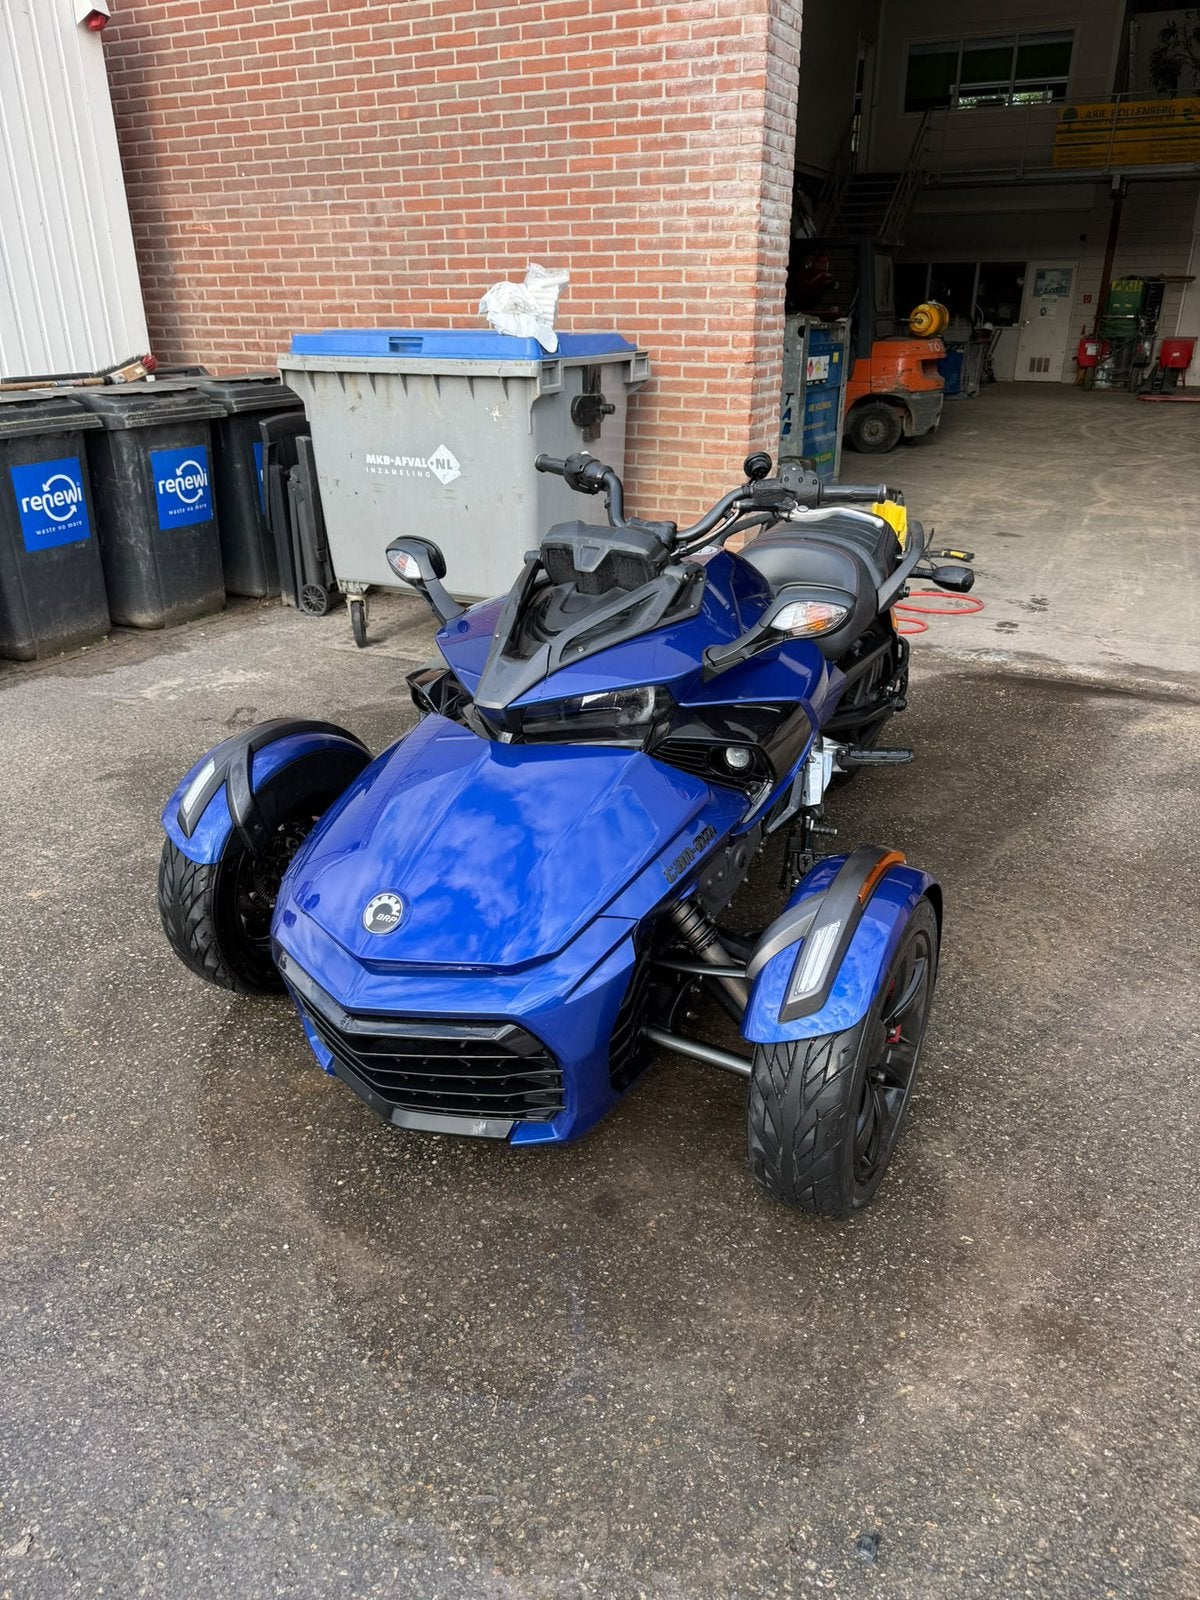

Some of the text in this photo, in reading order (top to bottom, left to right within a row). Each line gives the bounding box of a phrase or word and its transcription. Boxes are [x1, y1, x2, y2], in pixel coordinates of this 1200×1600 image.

[781, 392, 795, 435] TAB
[365, 466, 431, 478] INZAMELING
[158, 469, 208, 495] renewi
[21, 482, 84, 514] renewi
[168, 507, 186, 516] waste
[186, 505, 194, 513] no
[35, 519, 83, 536] waste no more
[376, 913, 398, 923] BRP
